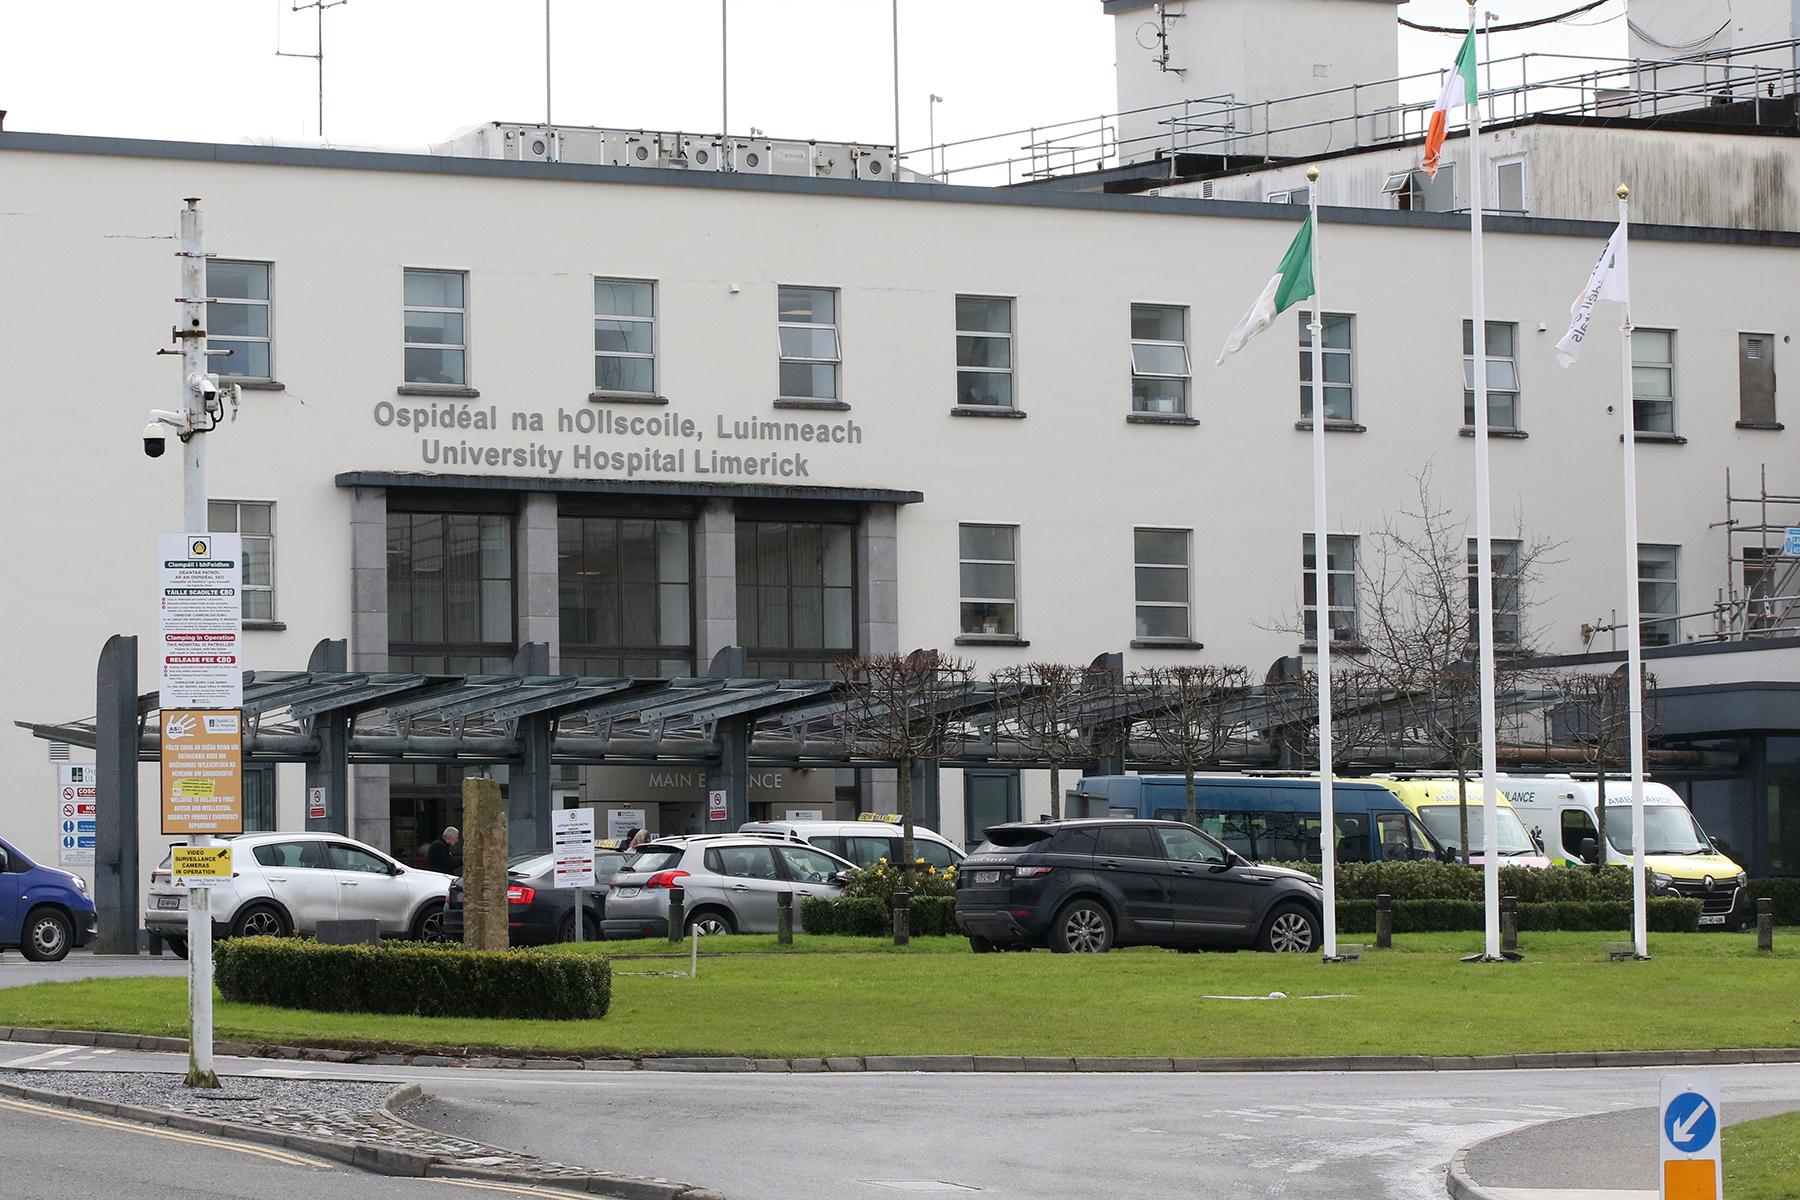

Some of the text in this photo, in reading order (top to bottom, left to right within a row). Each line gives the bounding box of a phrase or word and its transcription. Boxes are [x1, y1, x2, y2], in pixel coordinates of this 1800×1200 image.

[374, 401, 862, 444] Ospidéal na hOllscoile, Luimneach
[422, 438, 810, 477] University Hospital Limerick
[649, 774, 692, 787] MAIN
[1501, 792, 1536, 802] LANCE
[1608, 796, 1673, 805] AMBANCE
